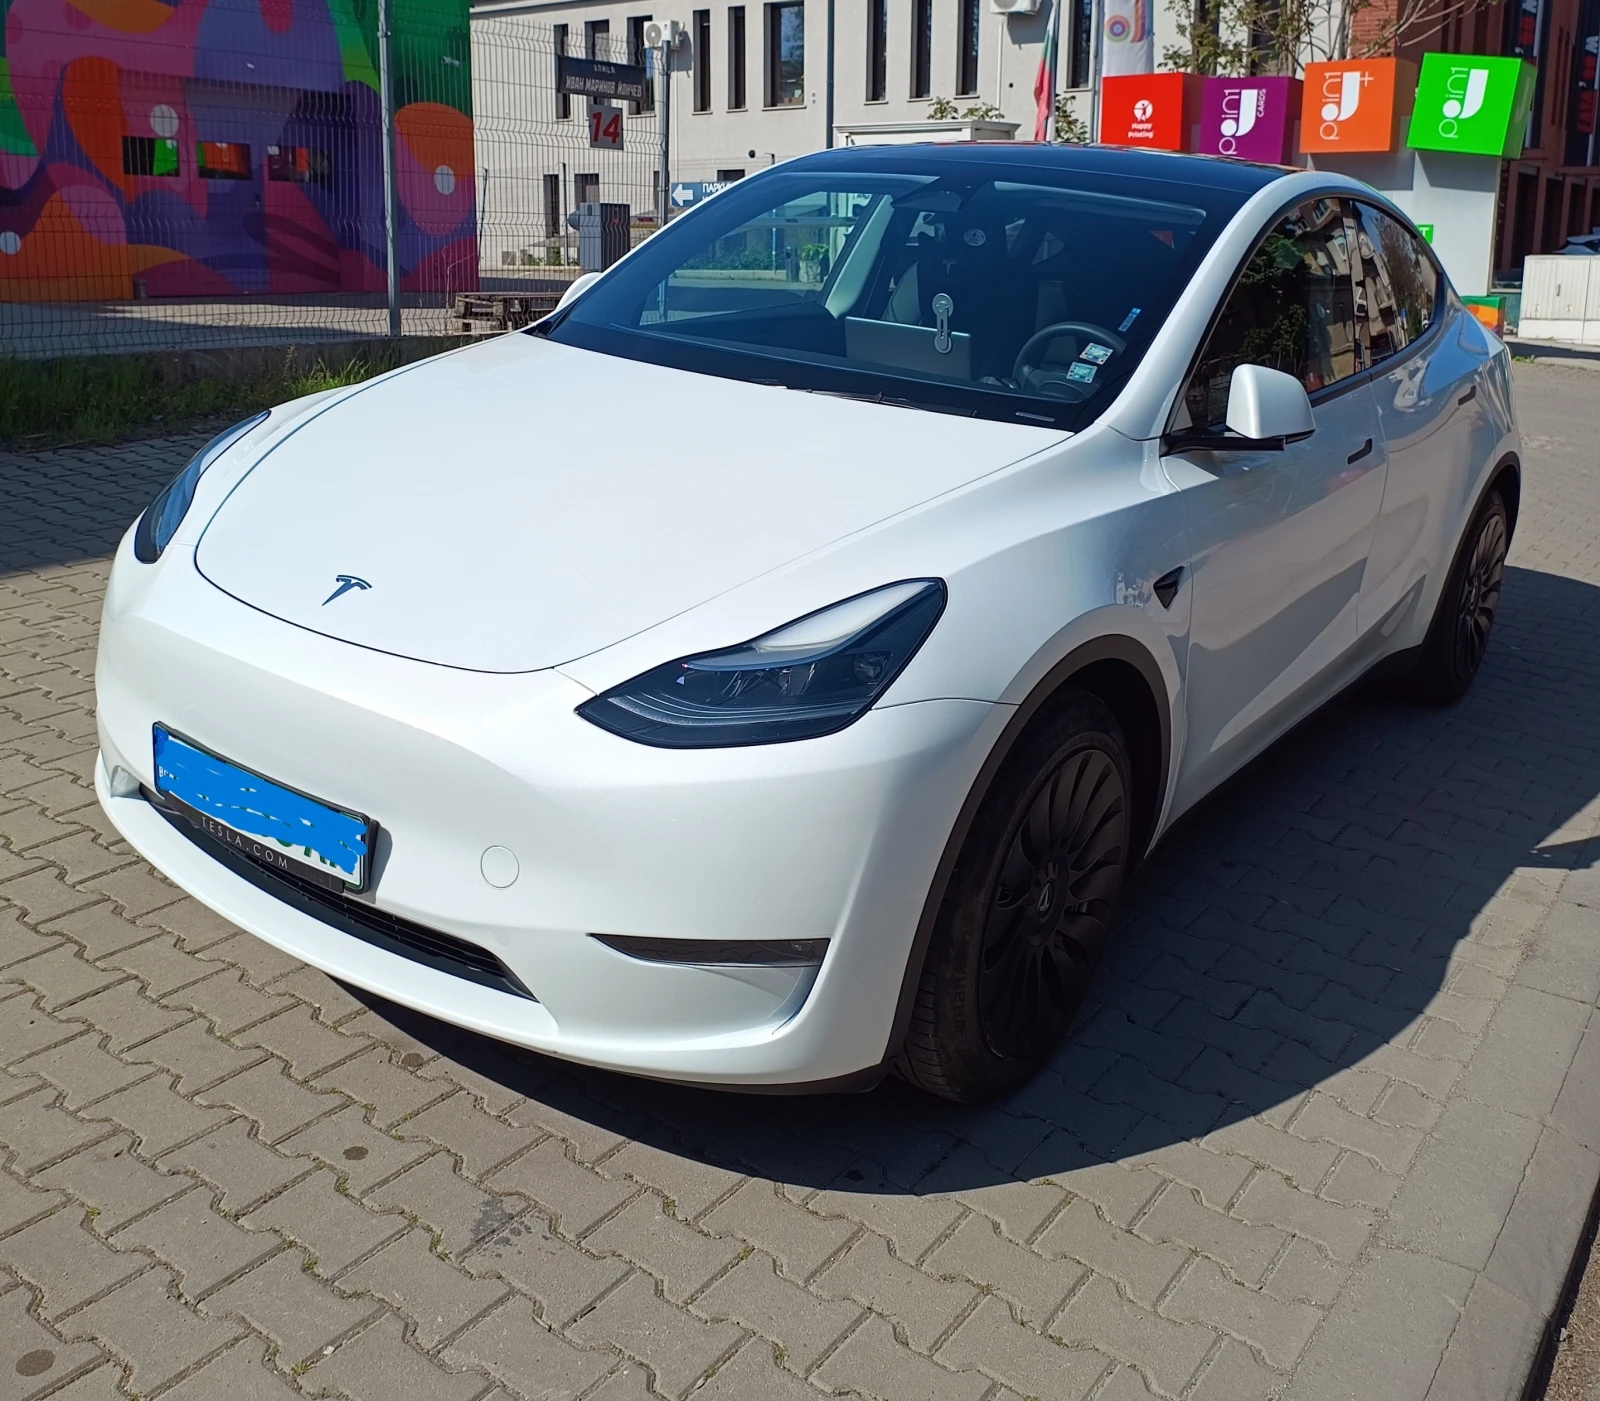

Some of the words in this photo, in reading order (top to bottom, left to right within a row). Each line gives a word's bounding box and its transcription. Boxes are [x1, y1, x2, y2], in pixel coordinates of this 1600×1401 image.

[566, 75, 585, 91] ИВАН
[585, 78, 616, 94] МАРИНОВ
[592, 112, 620, 144] 14
